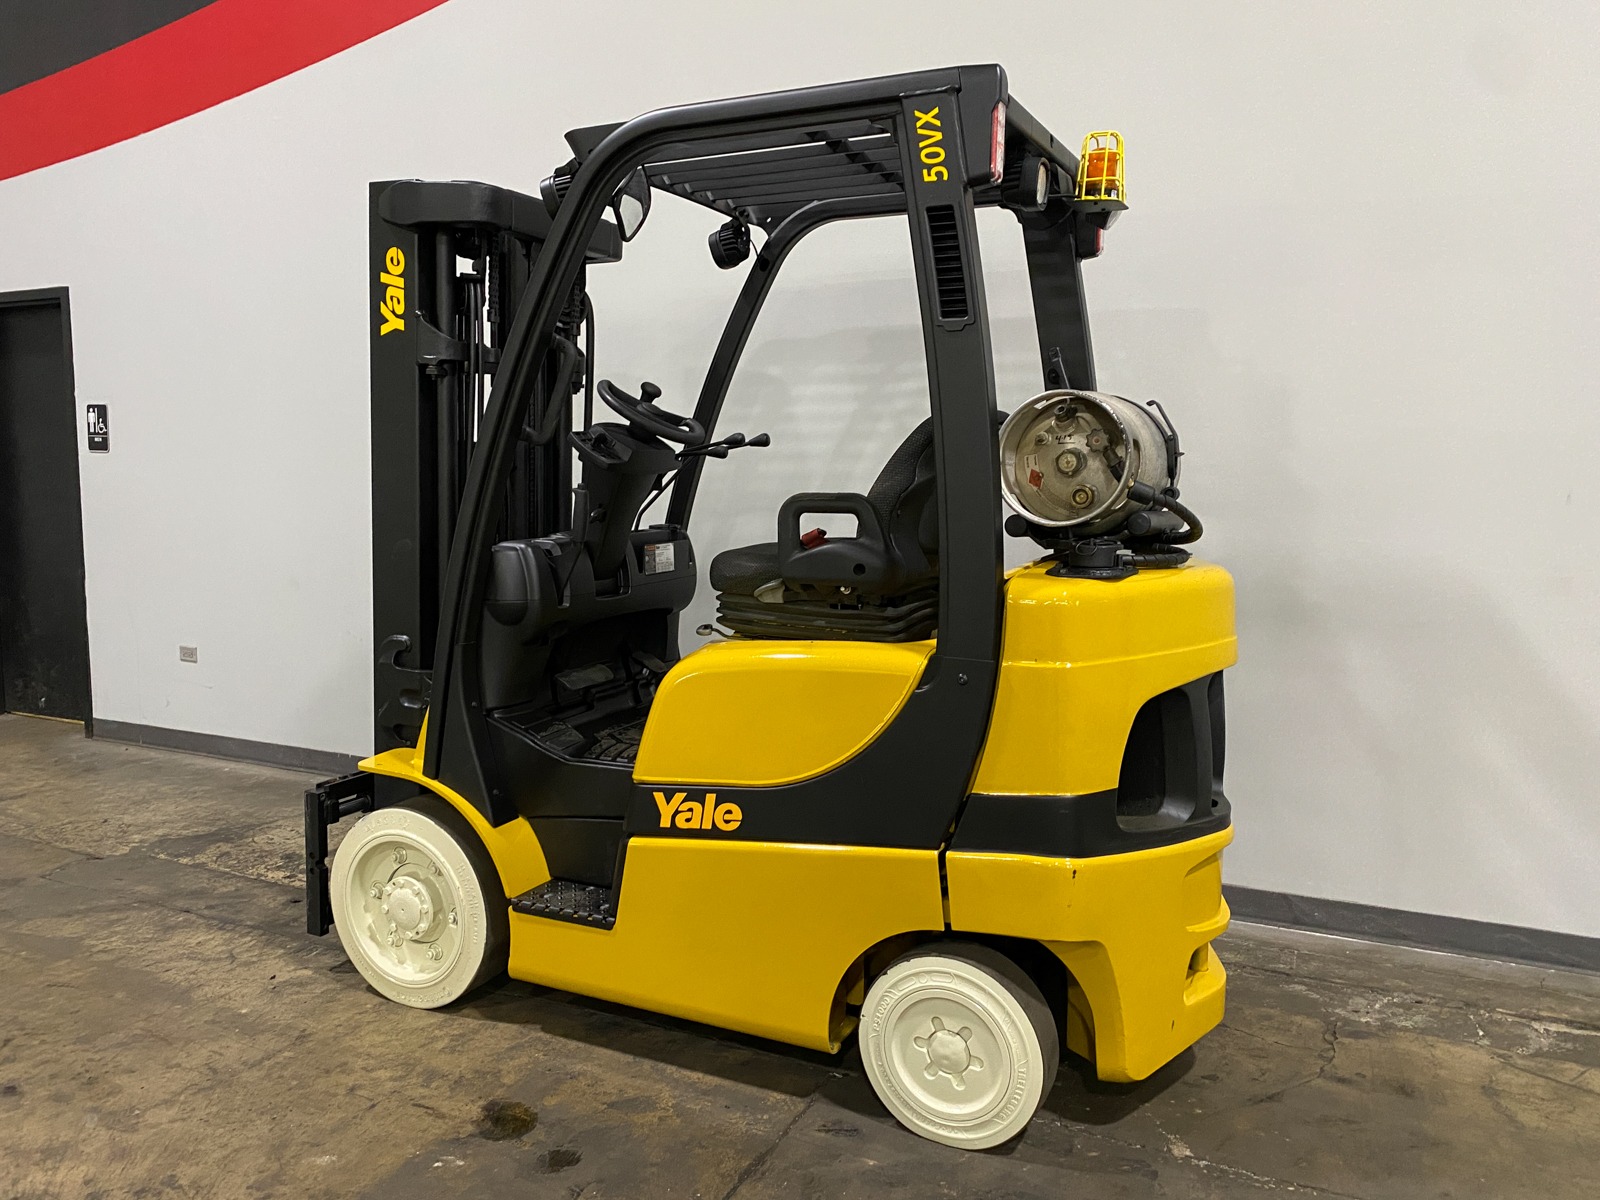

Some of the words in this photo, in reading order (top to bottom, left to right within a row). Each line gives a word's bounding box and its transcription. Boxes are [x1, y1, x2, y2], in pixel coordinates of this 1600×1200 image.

[913, 106, 949, 182] 50VX
[380, 246, 405, 335] Yale
[652, 791, 743, 832] Yale
